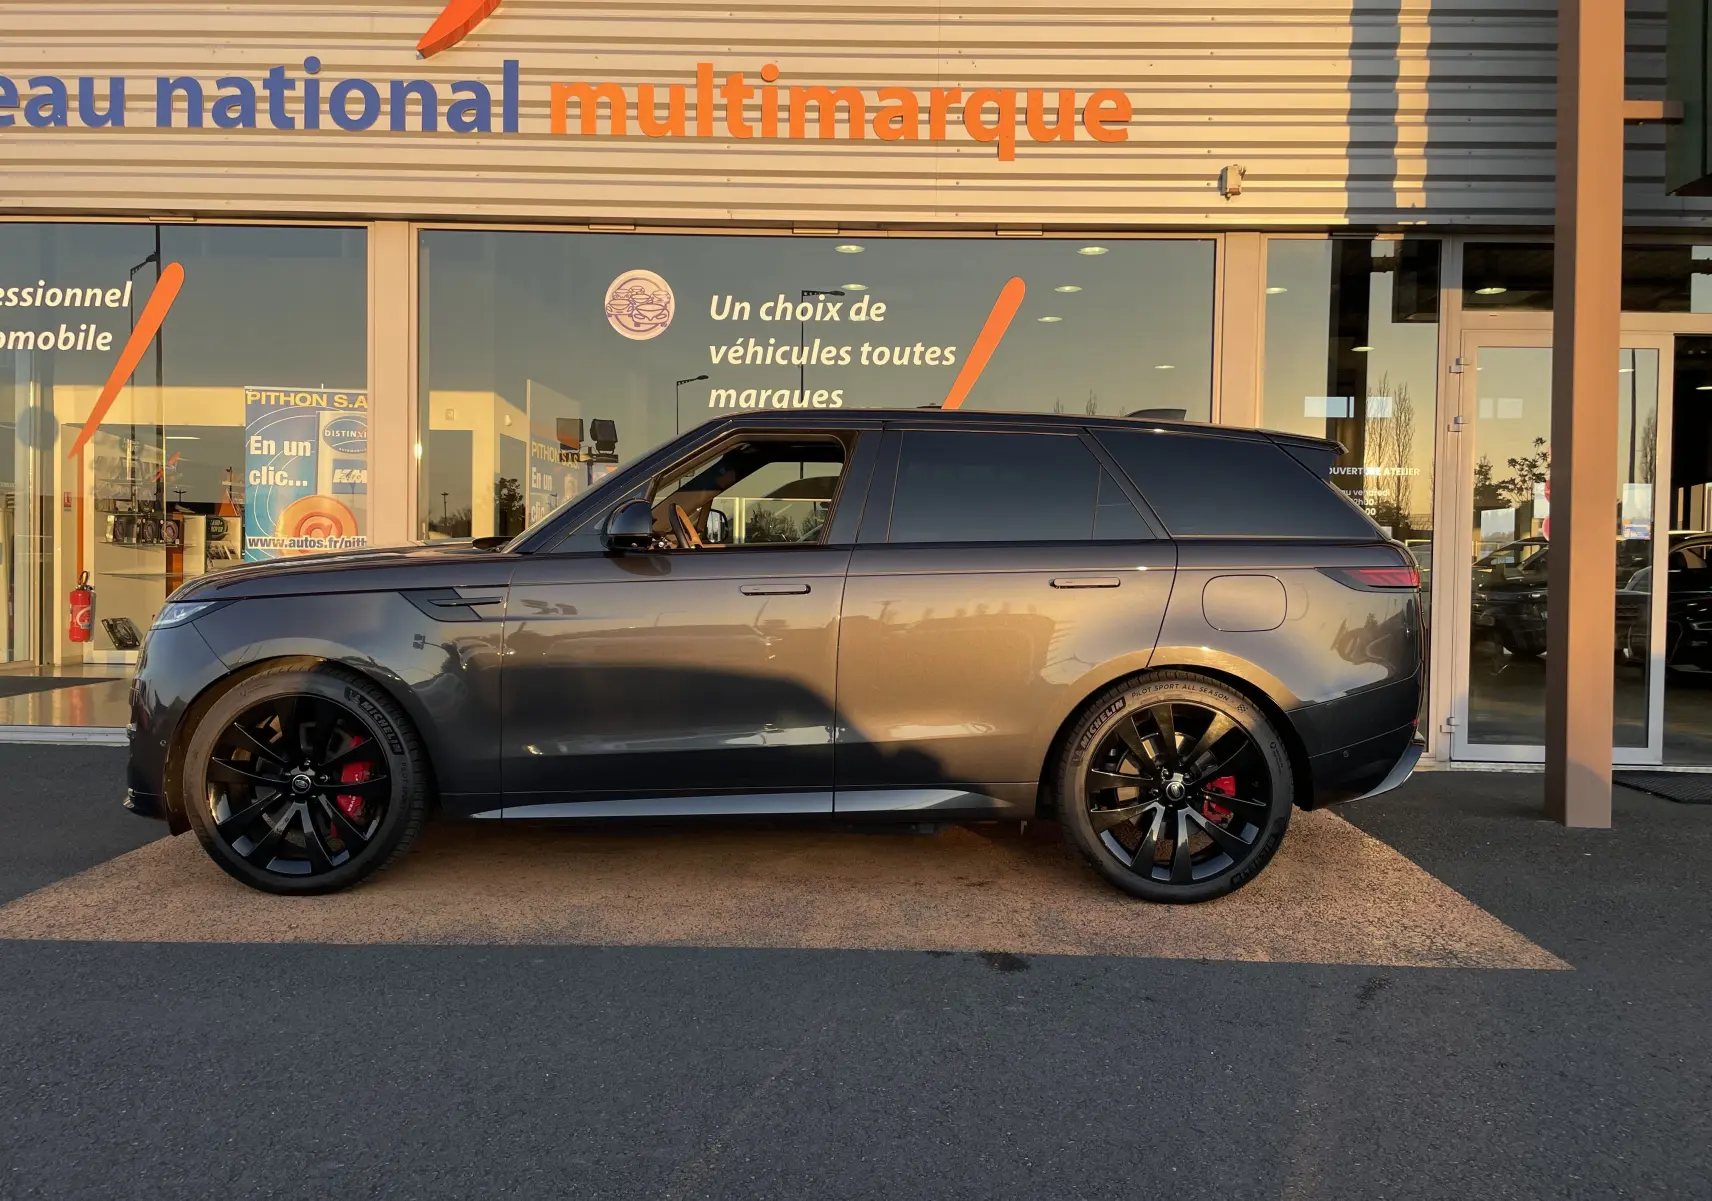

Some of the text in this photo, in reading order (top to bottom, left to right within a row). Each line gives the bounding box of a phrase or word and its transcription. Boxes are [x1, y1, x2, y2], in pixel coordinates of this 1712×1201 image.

[156, 56, 520, 133] national
[550, 62, 1133, 162] multimarque
[0, 279, 133, 308] ssionnel
[709, 294, 887, 322] Un choix de
[708, 338, 956, 366] véhicules toutes
[246, 391, 327, 408] PITHON
[249, 435, 311, 457] En un
[248, 465, 308, 487] clic...
[1154, 683, 1180, 692] SPORT
[1181, 683, 1197, 691] ALL
[1199, 686, 1230, 701] SEASON
[1080, 698, 1125, 750] MICHELIN
